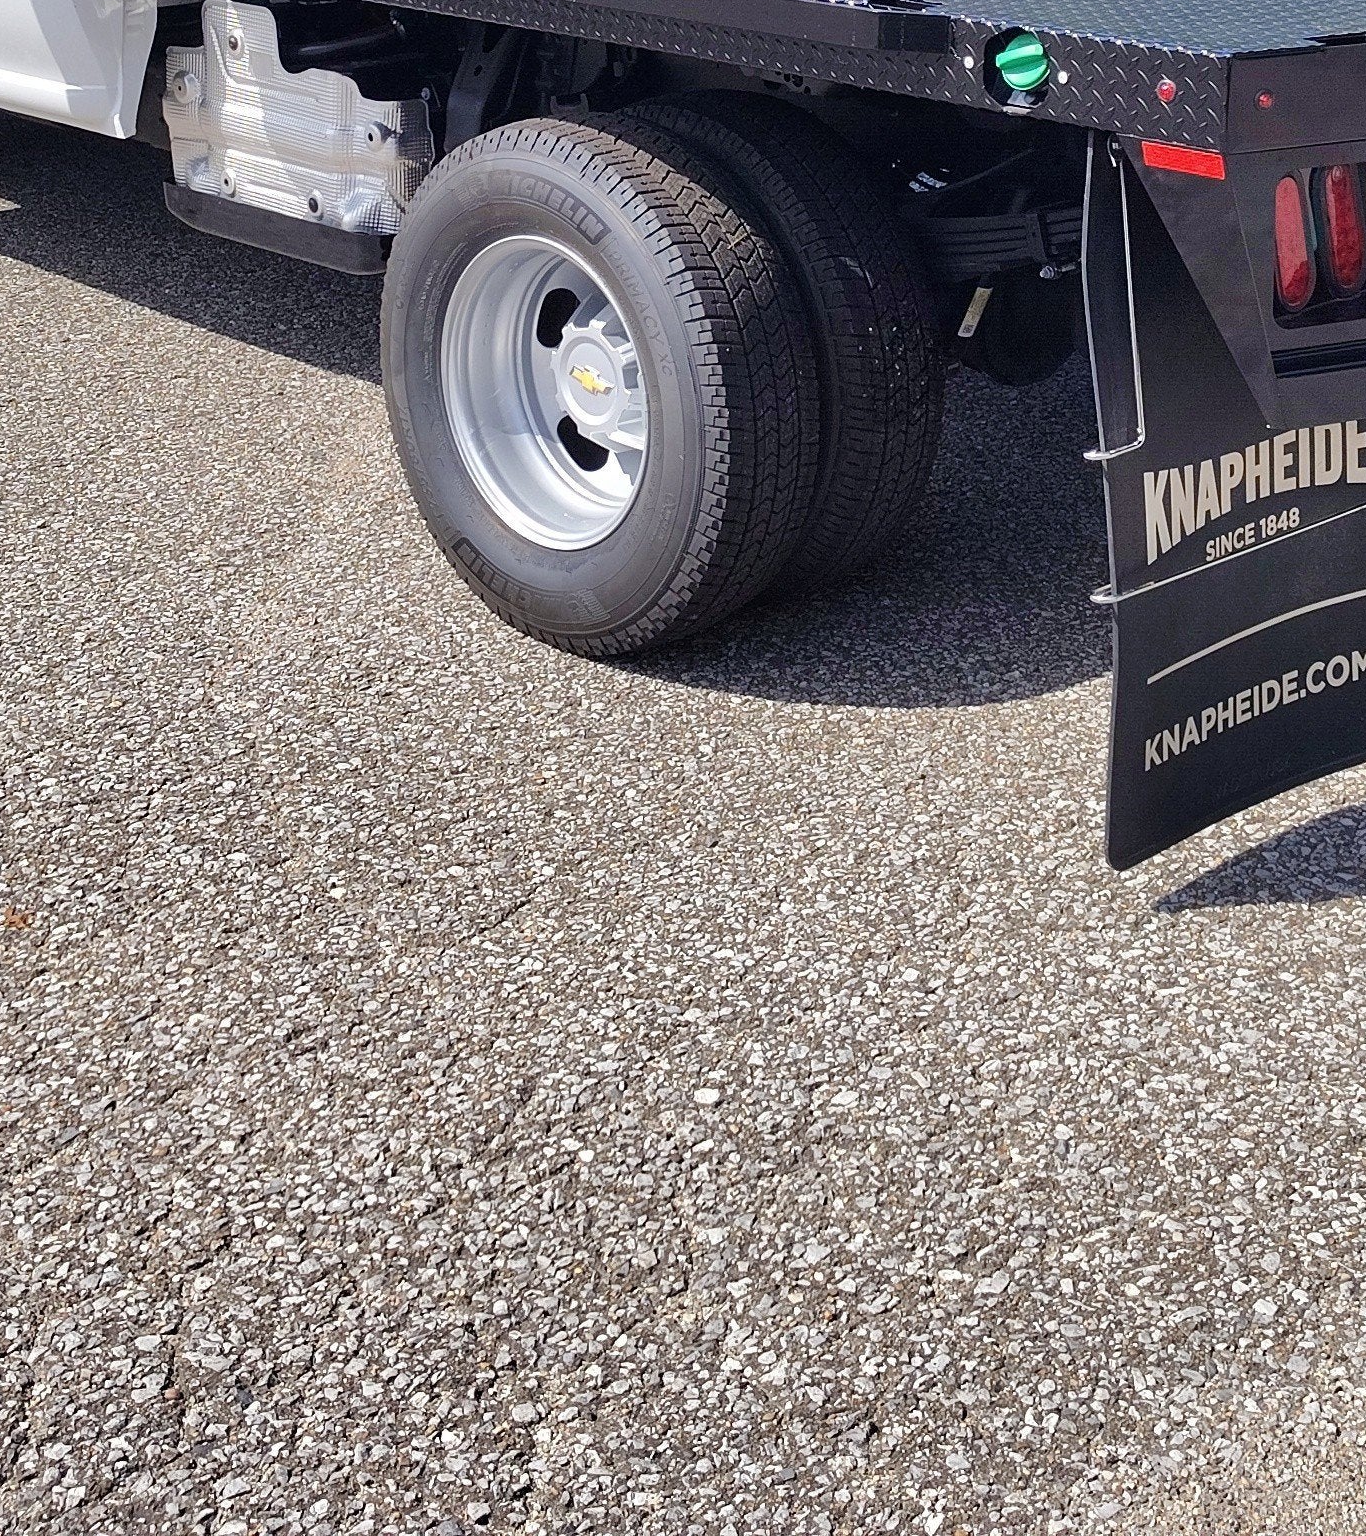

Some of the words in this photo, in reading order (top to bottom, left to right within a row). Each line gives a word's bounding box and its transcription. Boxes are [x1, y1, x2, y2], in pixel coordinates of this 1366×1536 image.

[608, 240, 663, 346] PRIMACY
[1205, 522, 1255, 562] SINCE
[1259, 507, 1301, 539] 1848
